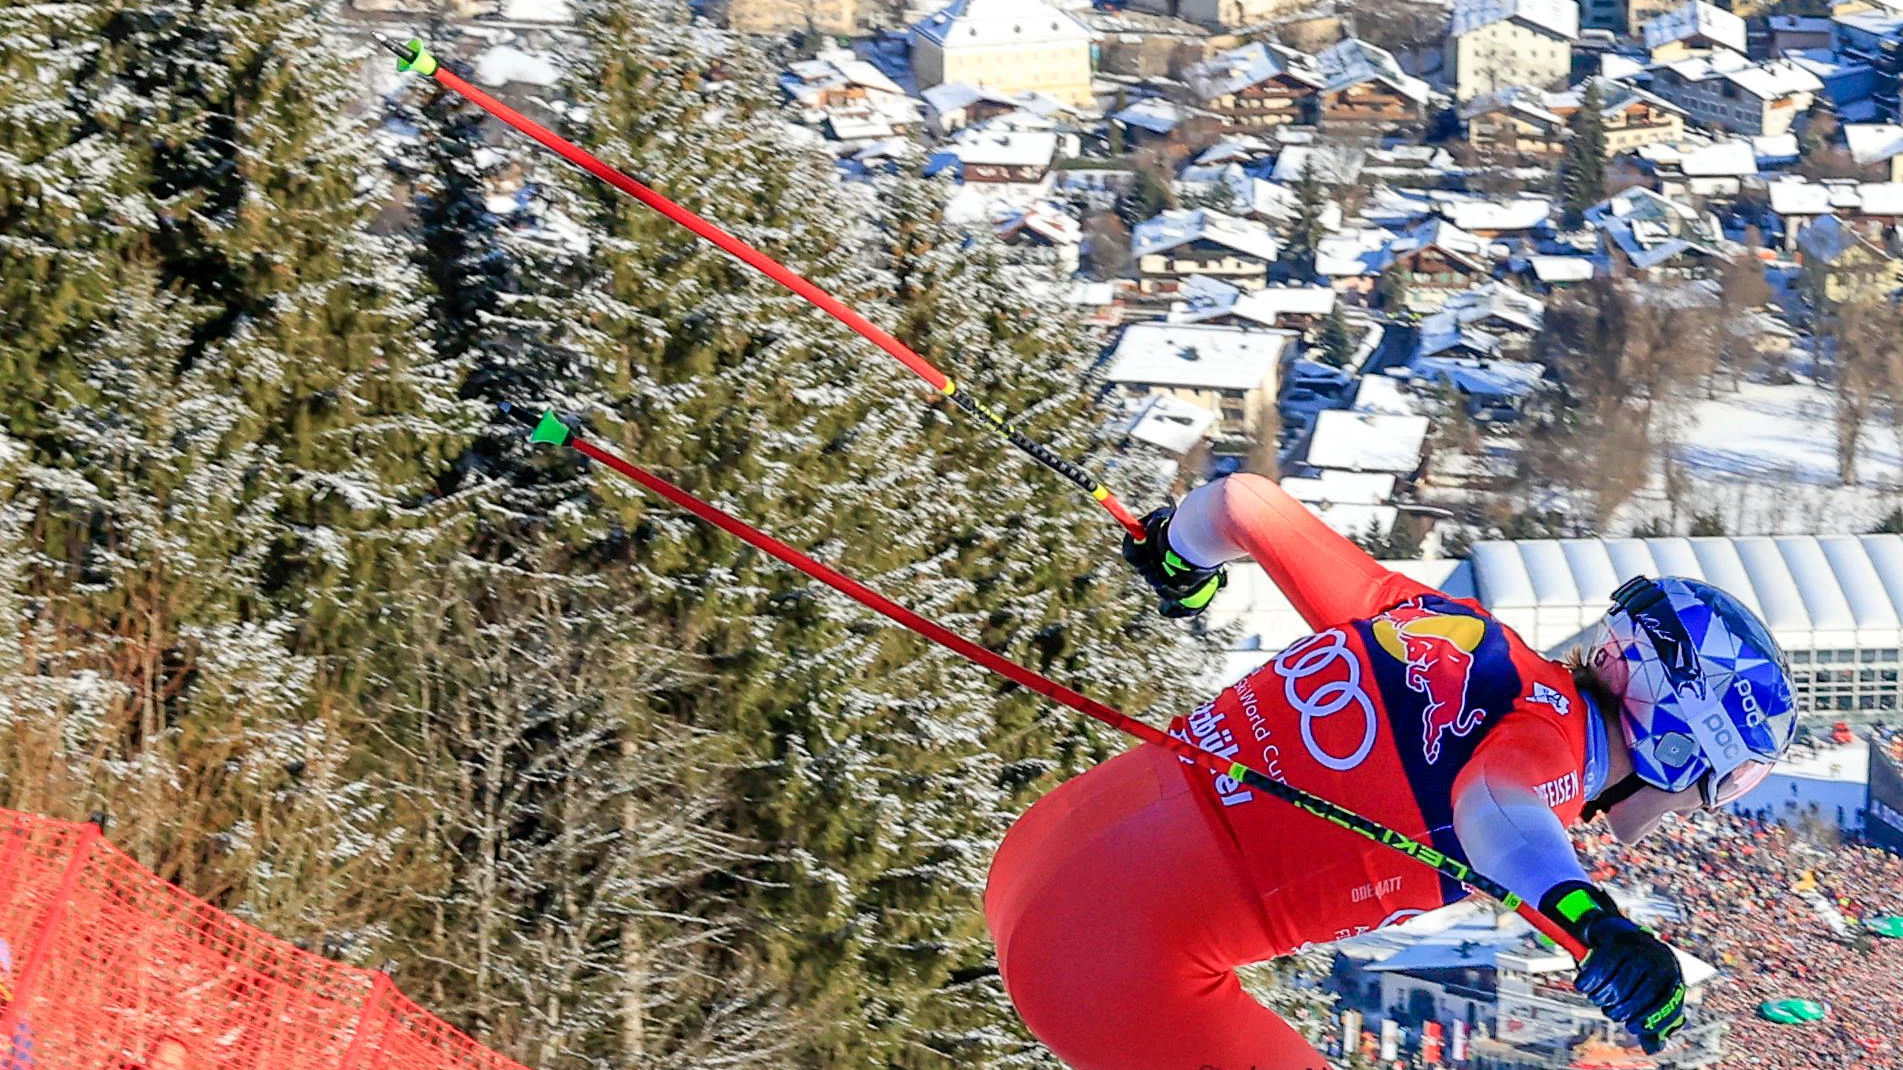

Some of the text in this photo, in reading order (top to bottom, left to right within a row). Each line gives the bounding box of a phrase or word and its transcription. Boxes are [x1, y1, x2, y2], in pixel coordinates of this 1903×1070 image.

[1735, 679, 1761, 728] poc
[1703, 713, 1740, 760] poc
[1382, 829, 1468, 881] LEKI
